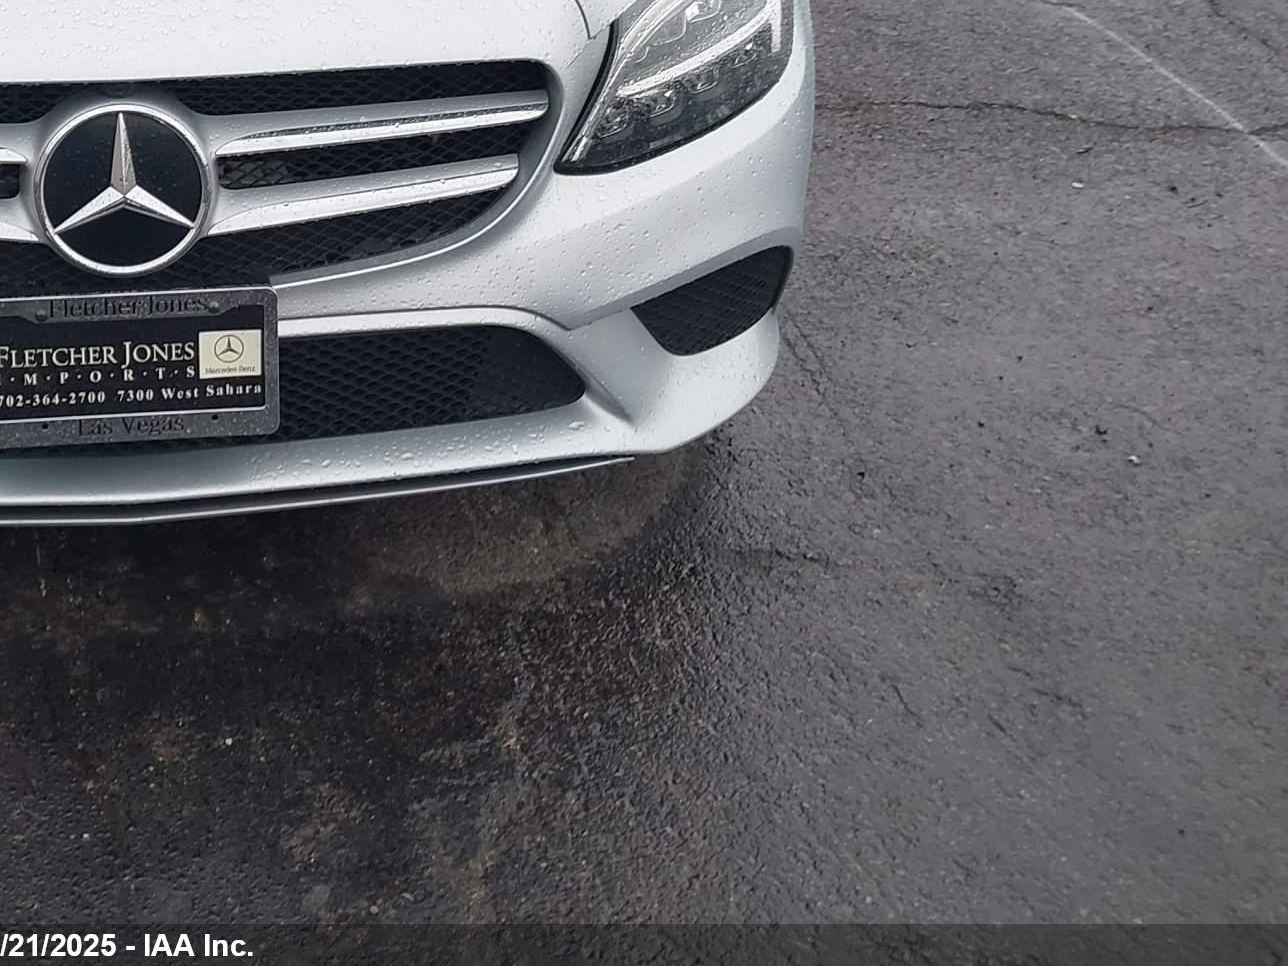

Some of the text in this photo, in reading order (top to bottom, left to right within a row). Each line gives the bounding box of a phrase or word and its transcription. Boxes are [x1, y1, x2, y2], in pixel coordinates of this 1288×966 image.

[49, 295, 142, 318] Fletcher
[121, 340, 195, 369] JONES
[117, 389, 154, 403] 7300
[162, 386, 199, 401] West
[206, 383, 262, 397] Sahara
[79, 416, 184, 436] Las Vegas
